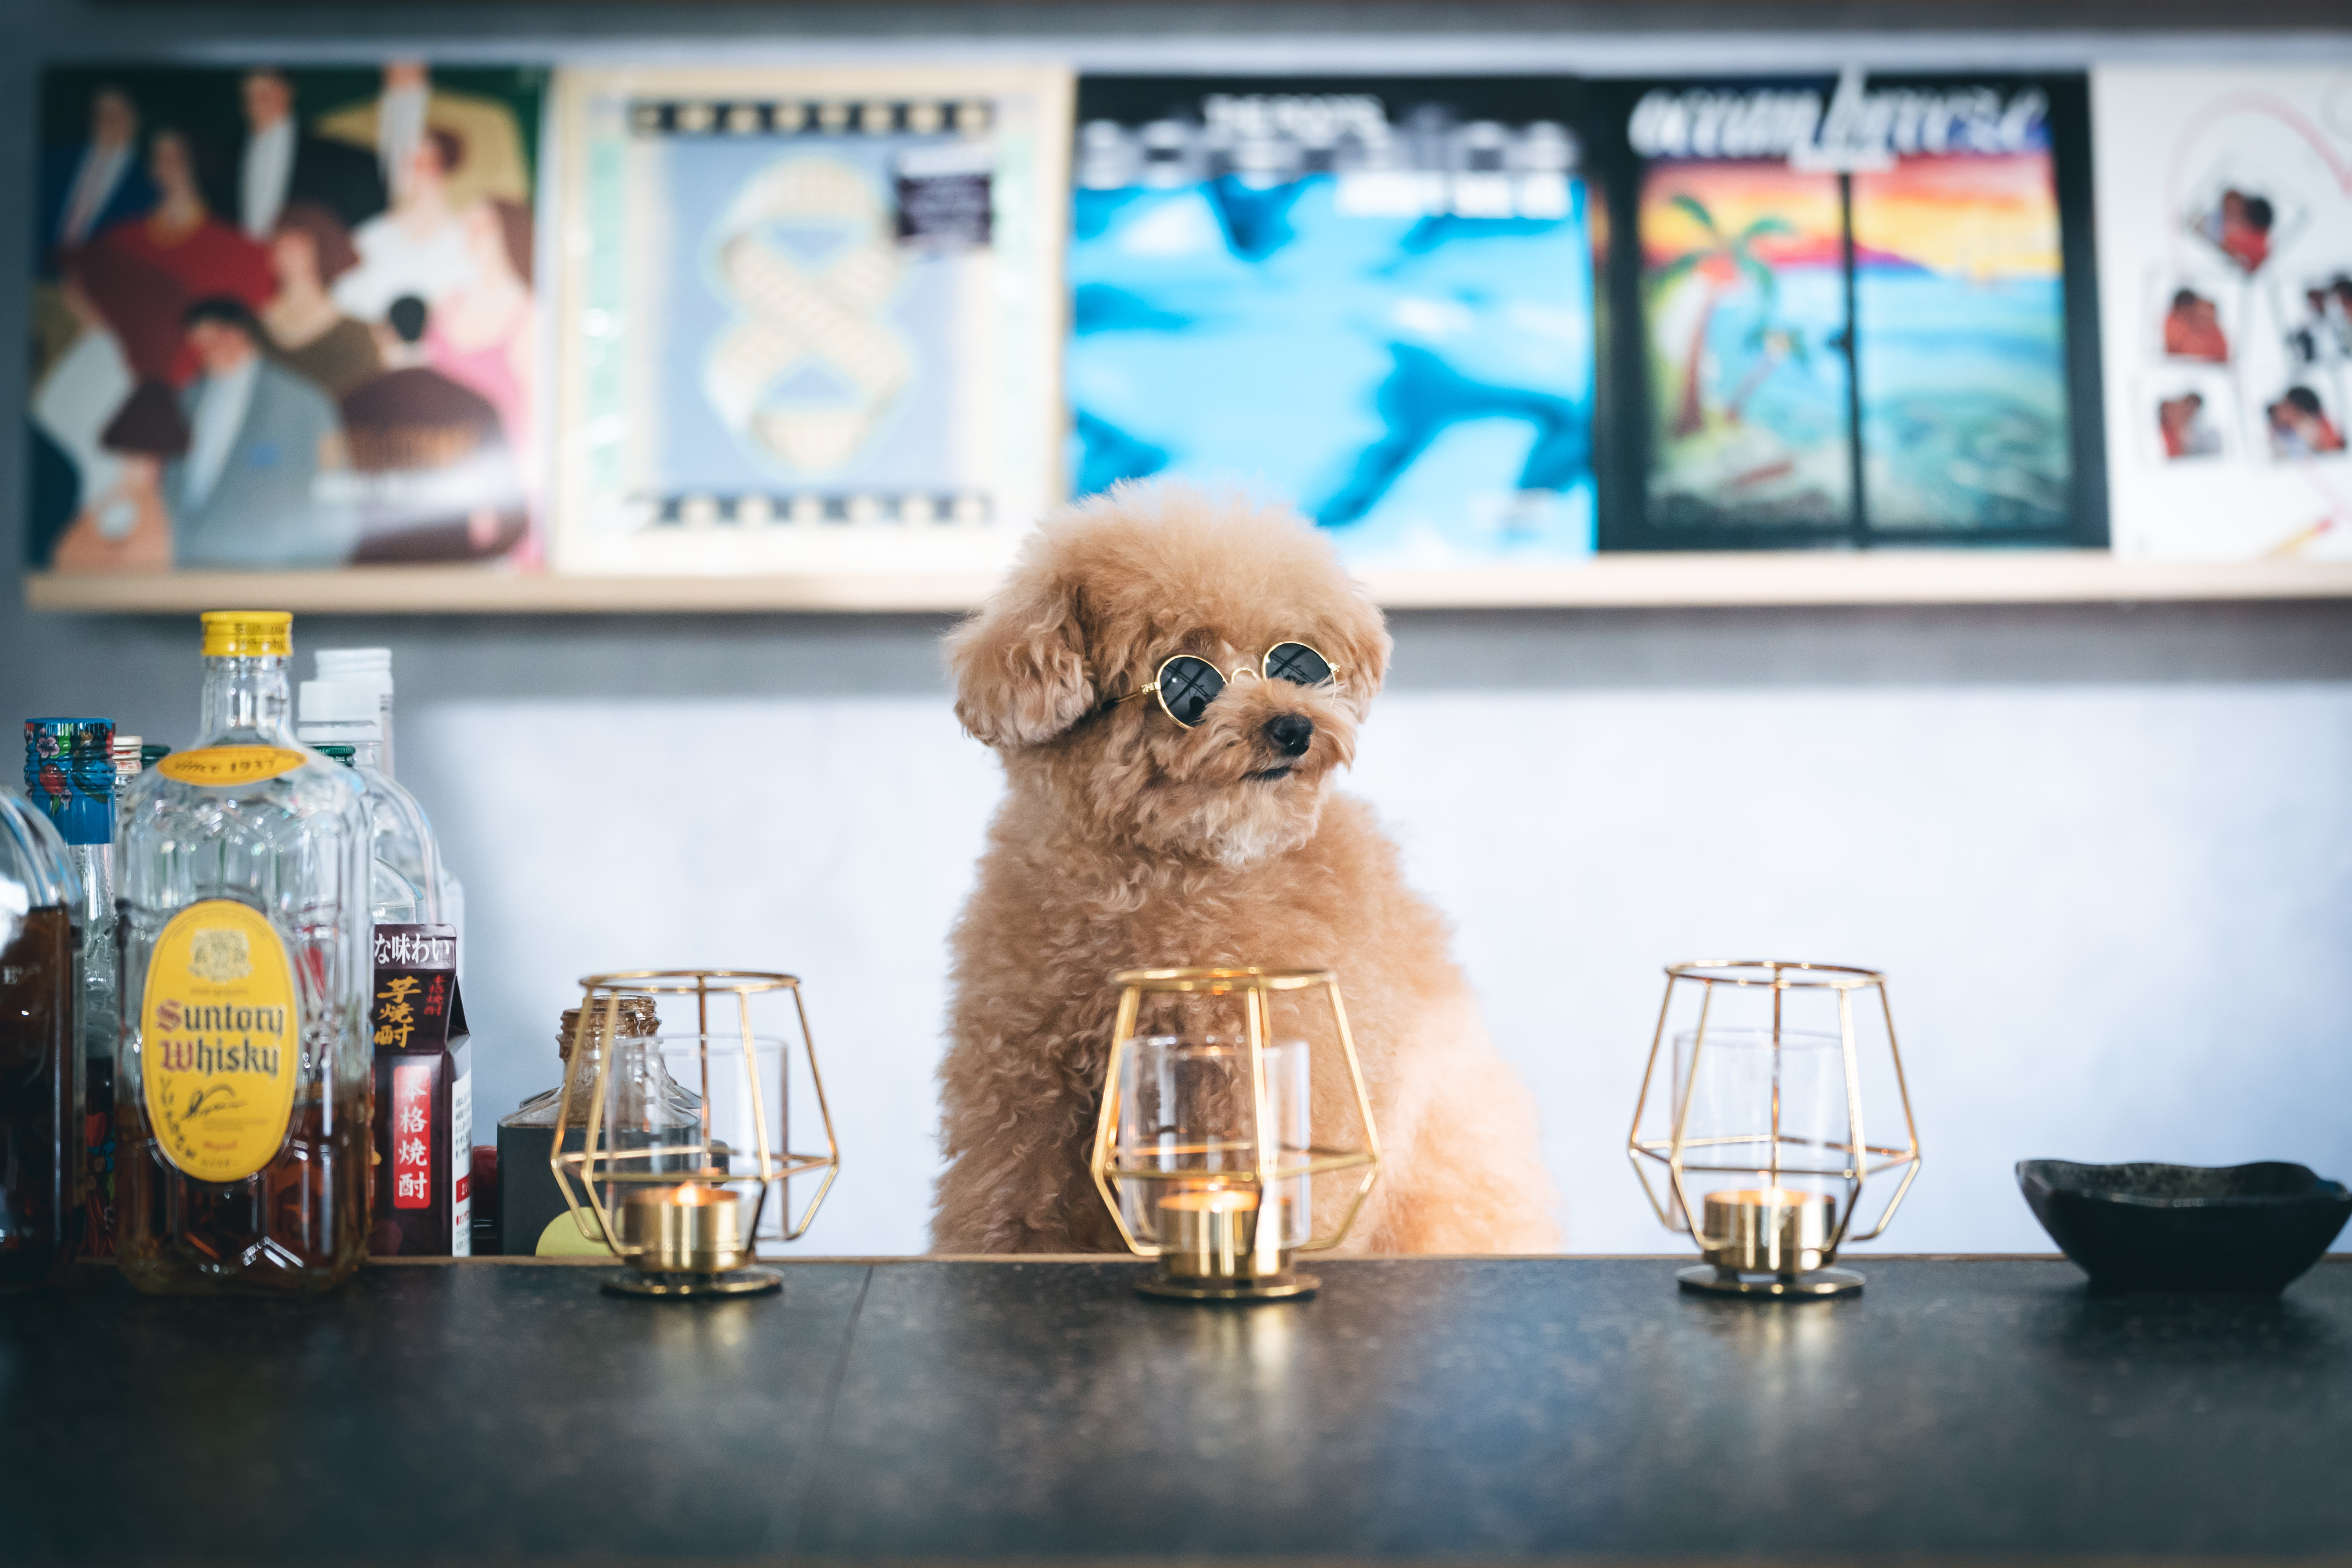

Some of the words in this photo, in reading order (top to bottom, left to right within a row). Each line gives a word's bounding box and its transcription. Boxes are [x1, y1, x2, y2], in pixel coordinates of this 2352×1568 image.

[230, 759, 275, 774] 1937
[375, 932, 450, 965] な味わい
[156, 998, 286, 1040] Suntory
[374, 975, 421, 1049] 芋焼酎
[158, 1036, 281, 1080] Whisky
[398, 1075, 428, 1200] 本格焼酎
